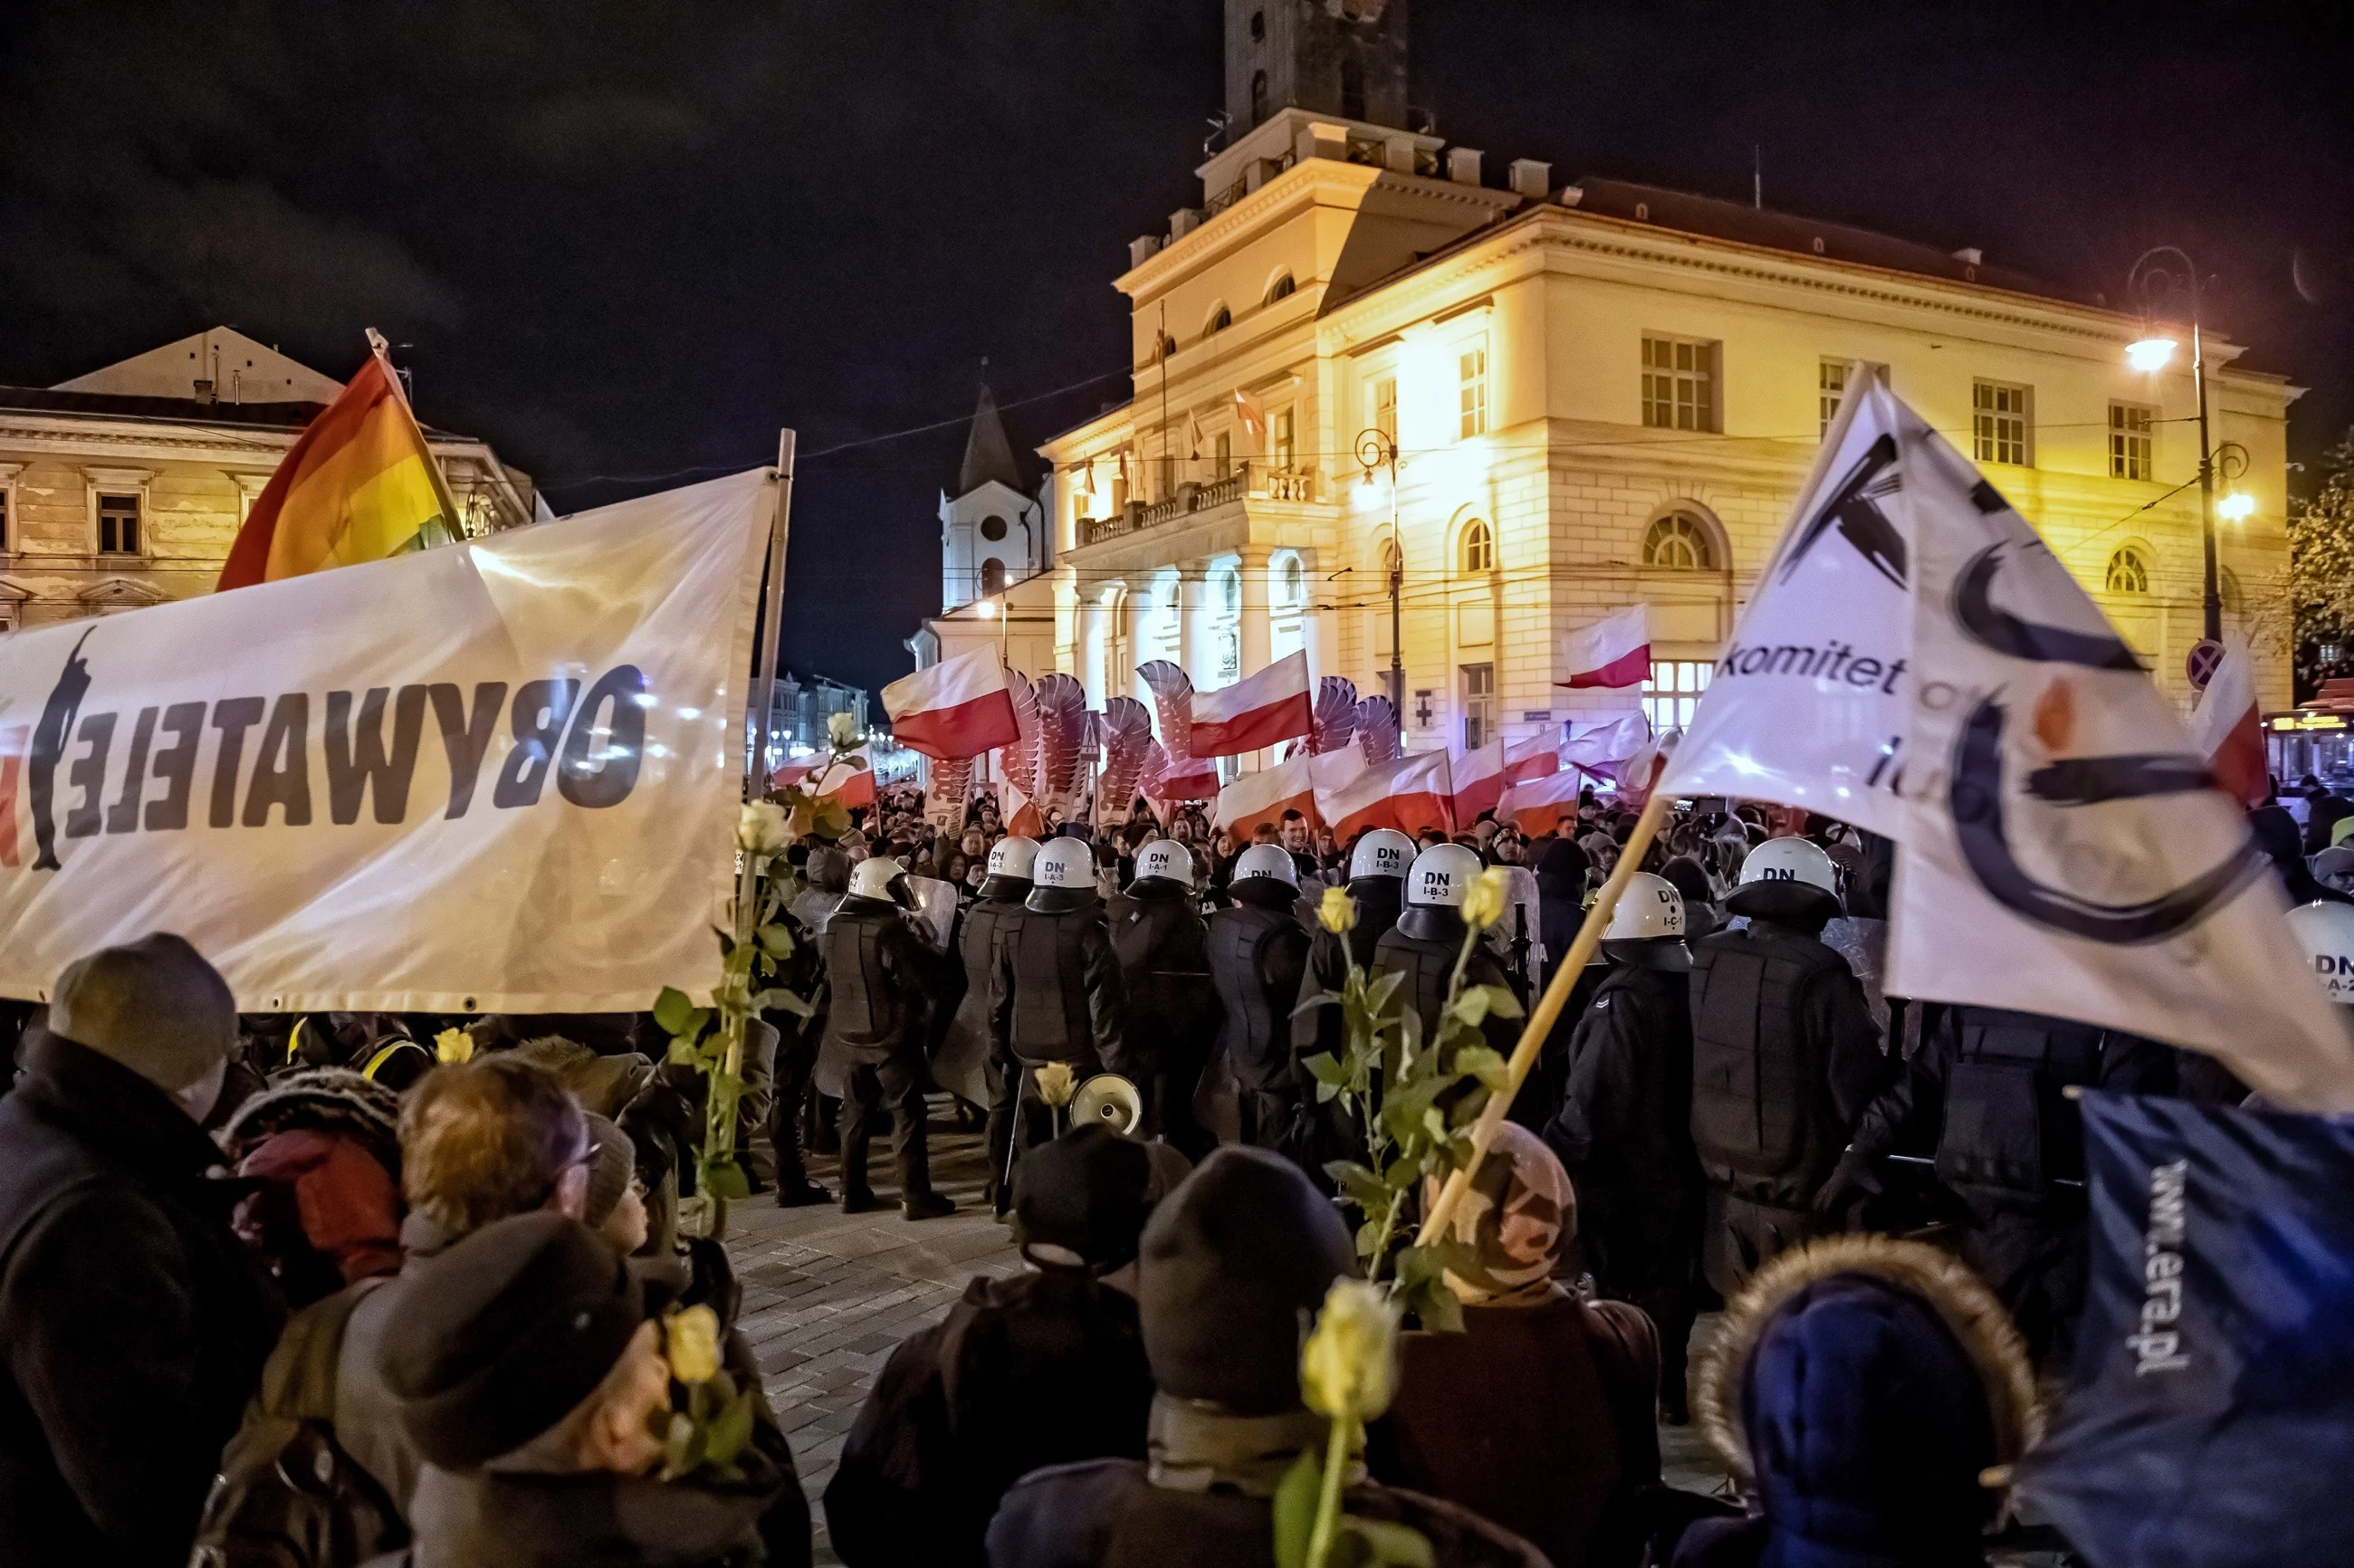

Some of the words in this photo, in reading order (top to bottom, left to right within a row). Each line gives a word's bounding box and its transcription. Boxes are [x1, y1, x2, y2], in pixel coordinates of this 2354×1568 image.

[1715, 639, 1906, 695] komitet
[991, 851, 1004, 861] DN
[1150, 853, 1169, 863] DN
[1377, 847, 1400, 859] DN
[1046, 861, 1065, 873] DN
[1149, 863, 1168, 871] I-A-1
[1424, 872, 1450, 886] DN
[1763, 868, 1794, 881] DN
[1423, 886, 1449, 896] I-B-3
[1657, 890, 1681, 904] DN
[2315, 954, 2354, 976] DN
